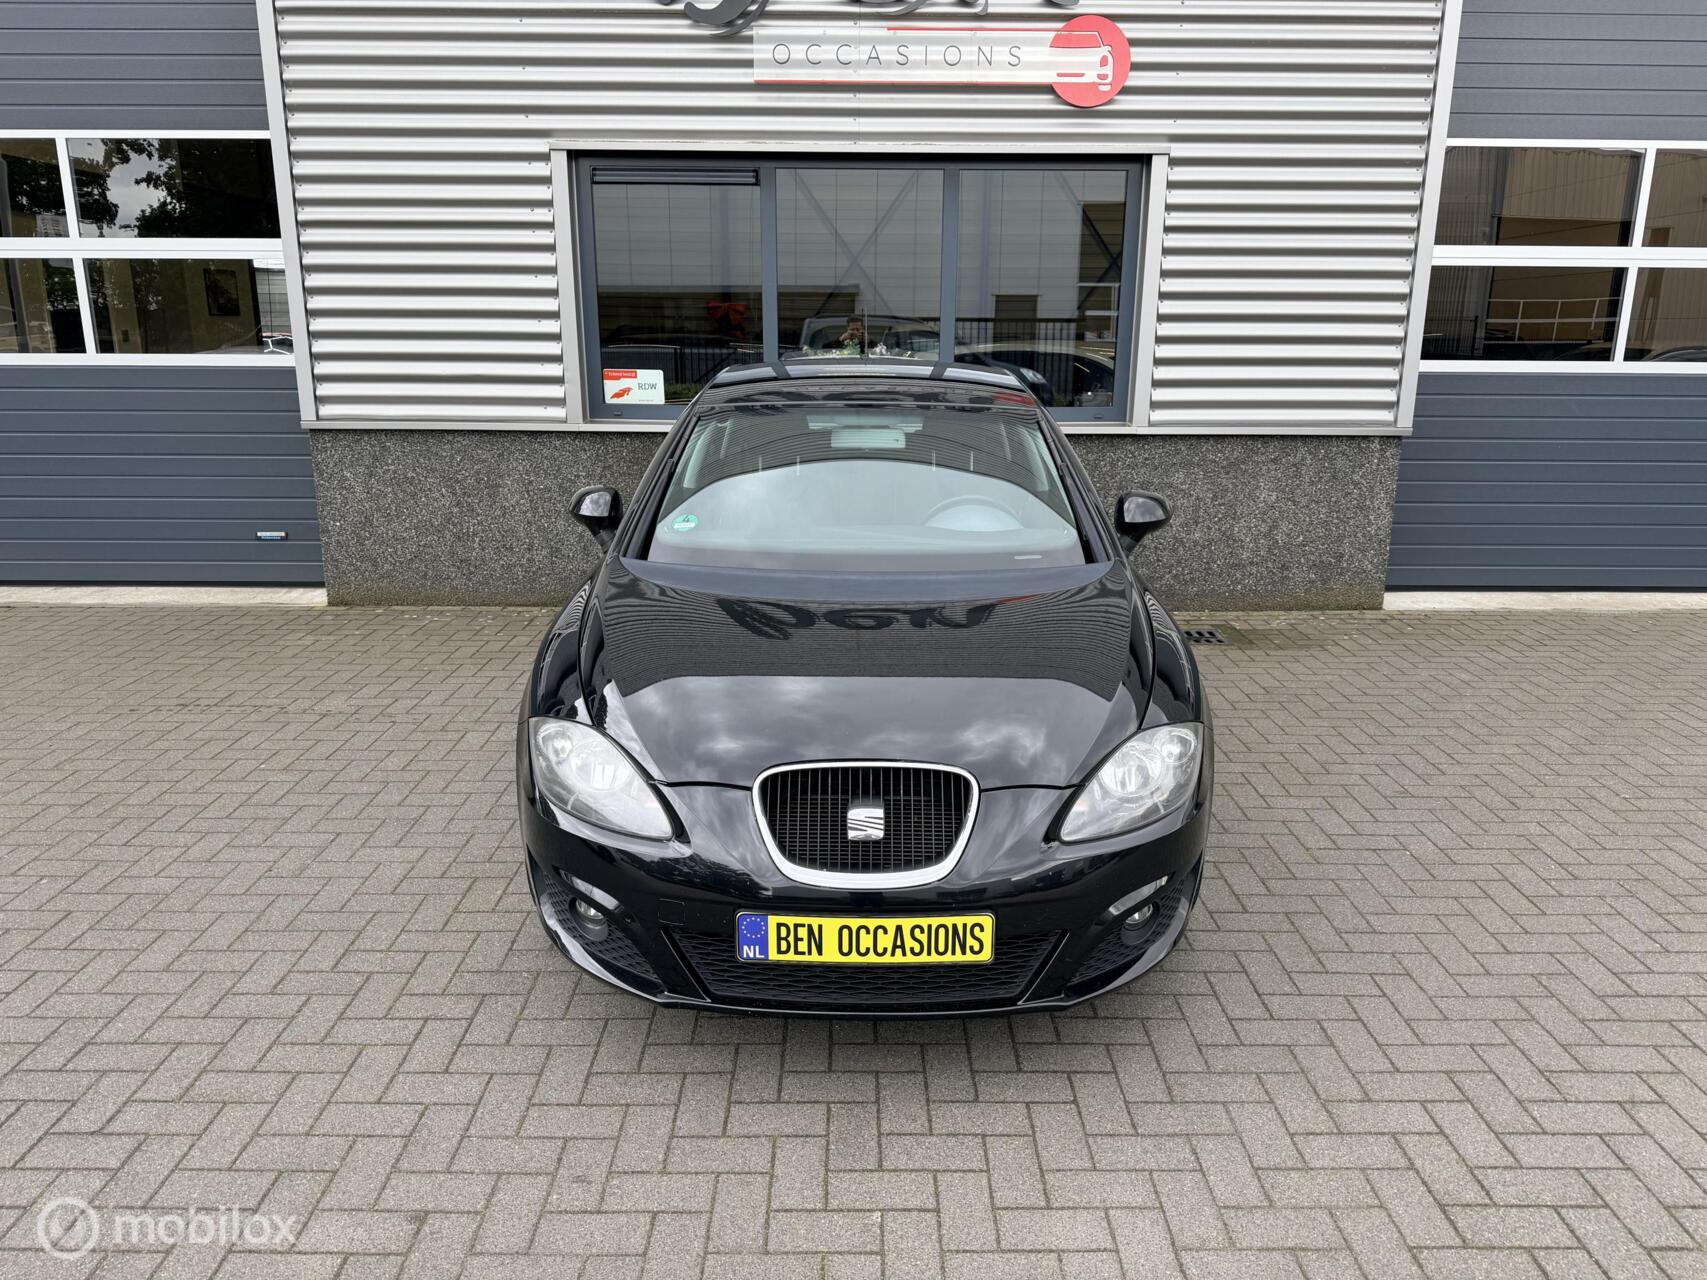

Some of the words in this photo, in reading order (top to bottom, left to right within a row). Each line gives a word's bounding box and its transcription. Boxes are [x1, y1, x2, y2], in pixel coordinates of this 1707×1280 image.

[772, 43, 1022, 67] OCCASIONS
[638, 382, 657, 390] RDW
[776, 922, 823, 956] BEN
[837, 922, 985, 957] OCCASIONS
[743, 945, 765, 958] NL
